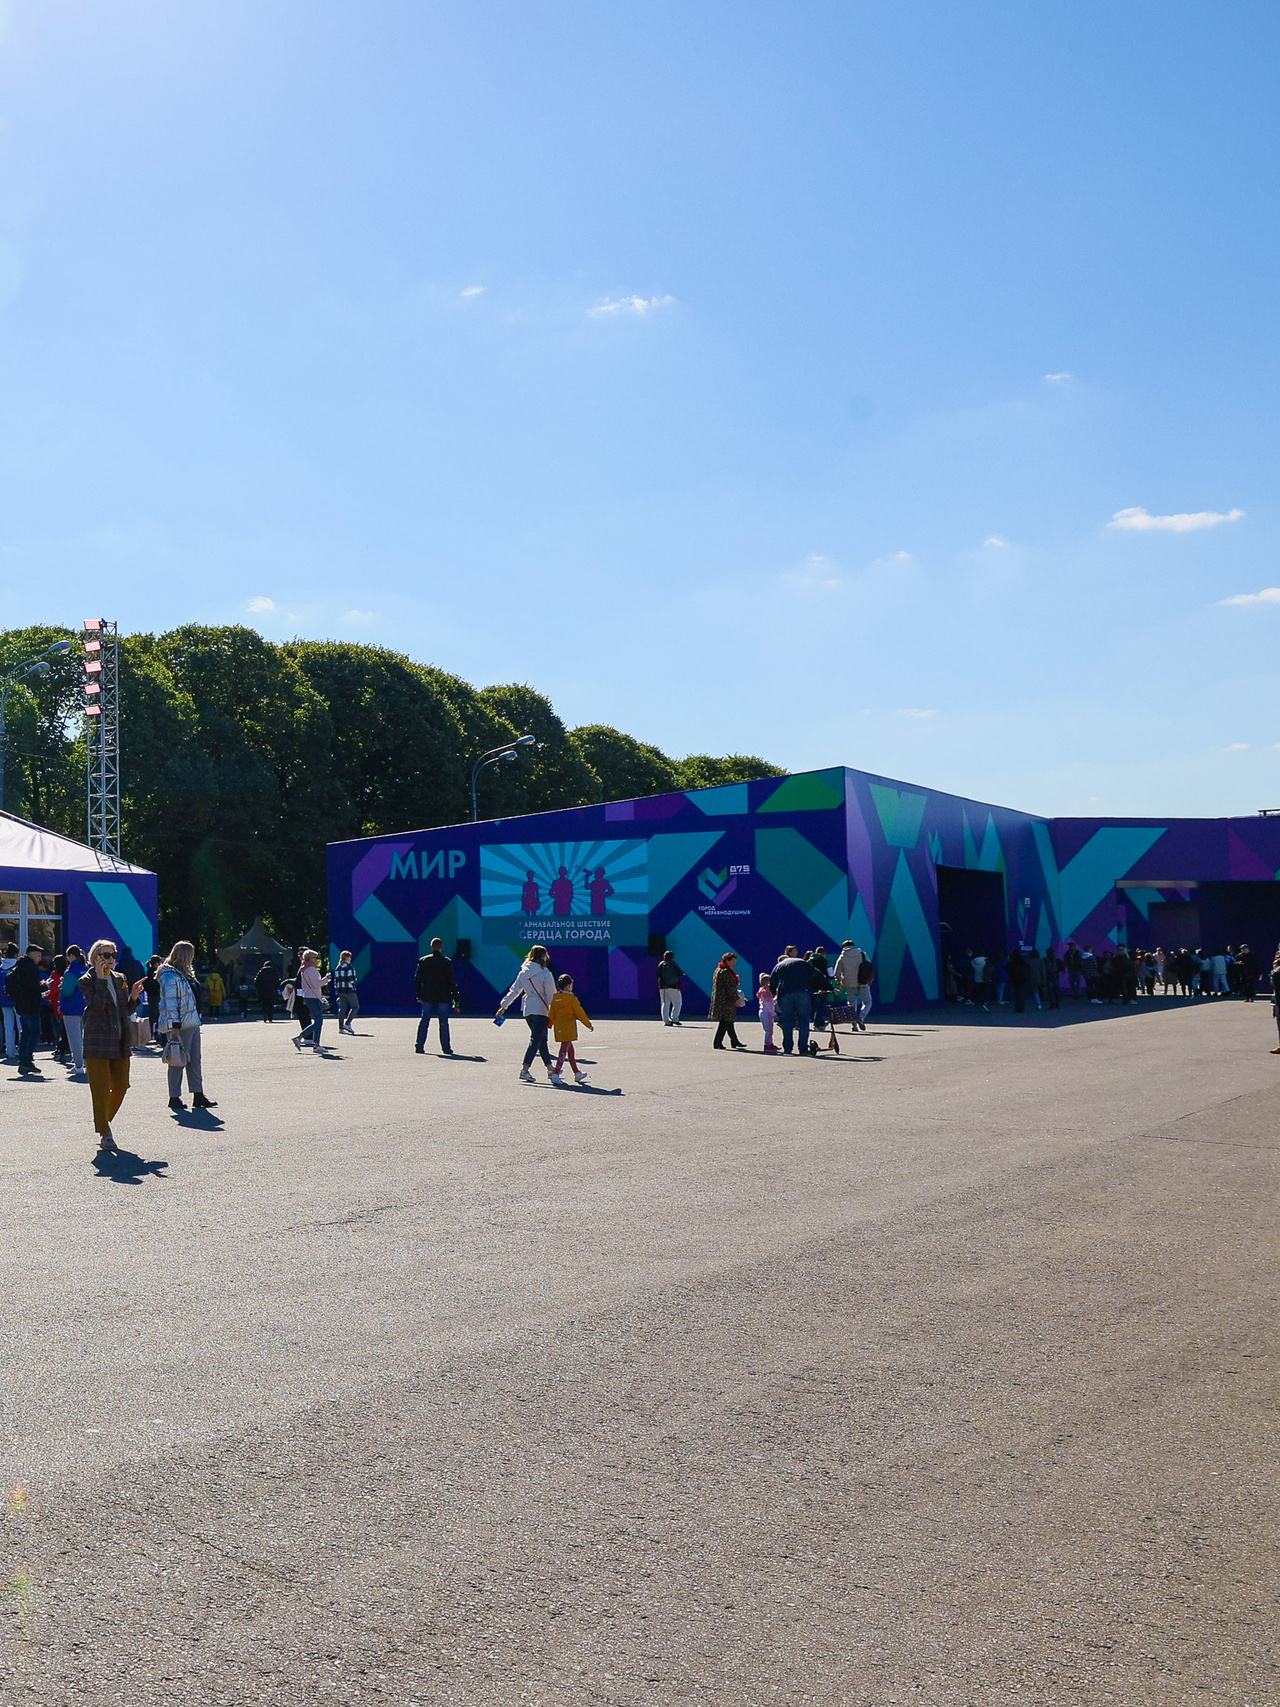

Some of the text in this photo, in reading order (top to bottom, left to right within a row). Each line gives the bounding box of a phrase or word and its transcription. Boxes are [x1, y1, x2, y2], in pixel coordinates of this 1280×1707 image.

[390, 849, 466, 880] МИР
[576, 920, 611, 928] ШЕСТВИЕ
[519, 929, 611, 941] СЕРДЦА ГОРОДА
